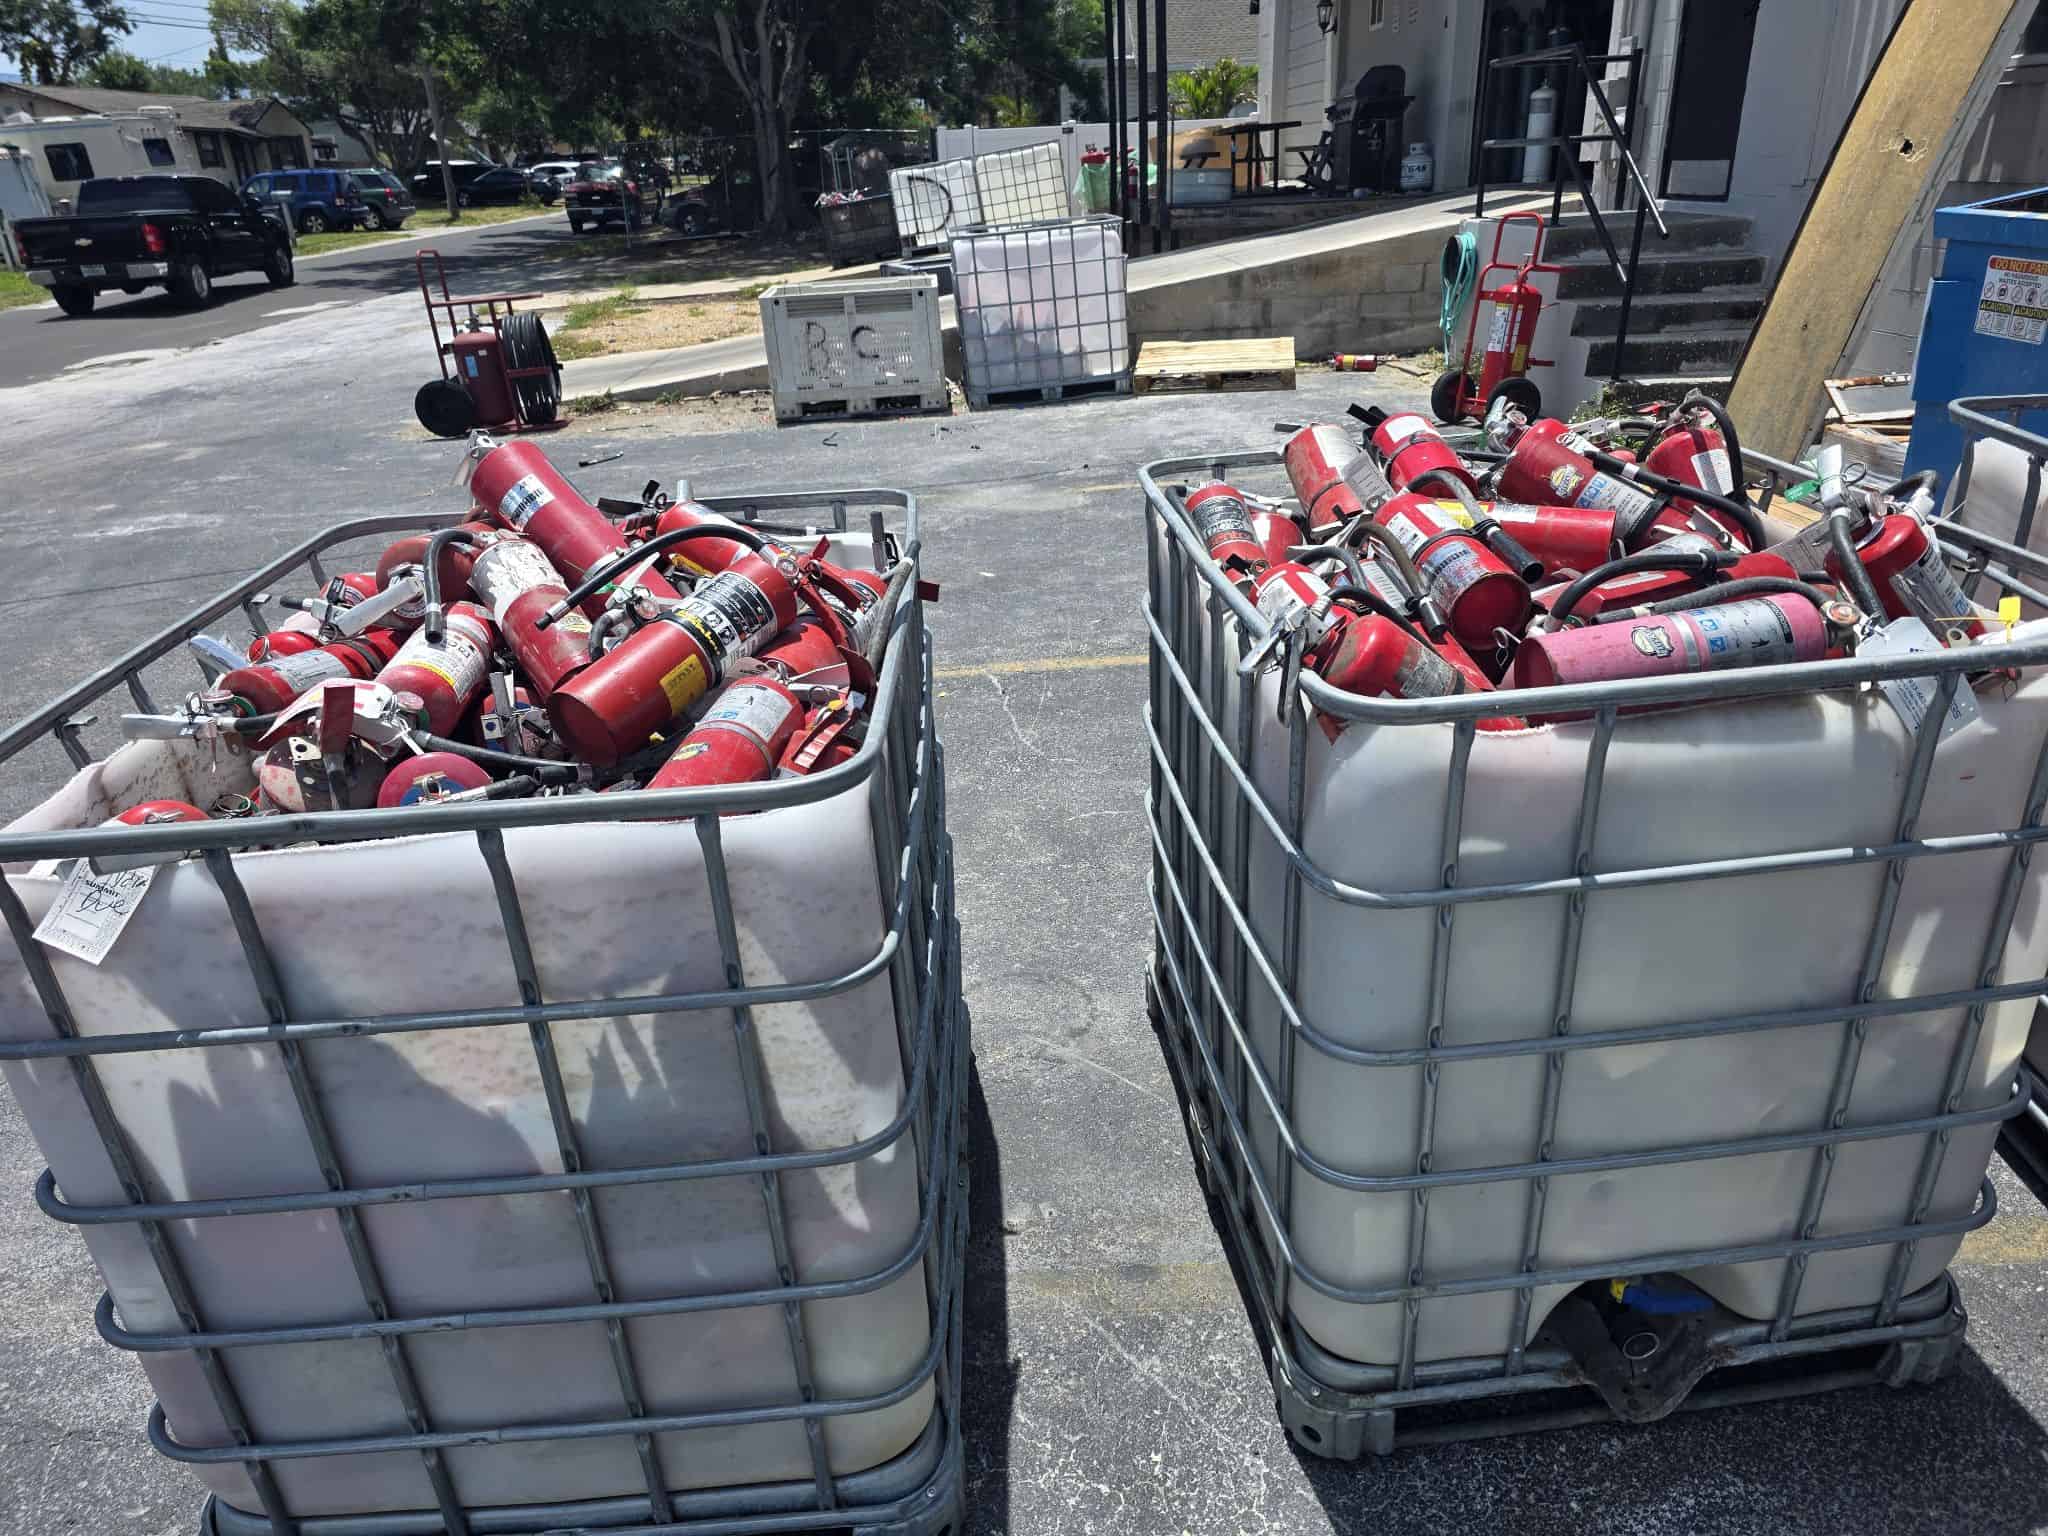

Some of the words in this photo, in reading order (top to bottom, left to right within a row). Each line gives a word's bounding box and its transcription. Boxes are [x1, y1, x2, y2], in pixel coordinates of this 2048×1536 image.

[907, 175, 953, 236] D
[1996, 260, 2009, 270] DO
[2010, 261, 2028, 271] NOT
[806, 321, 830, 375] B
[851, 325, 880, 359] C
